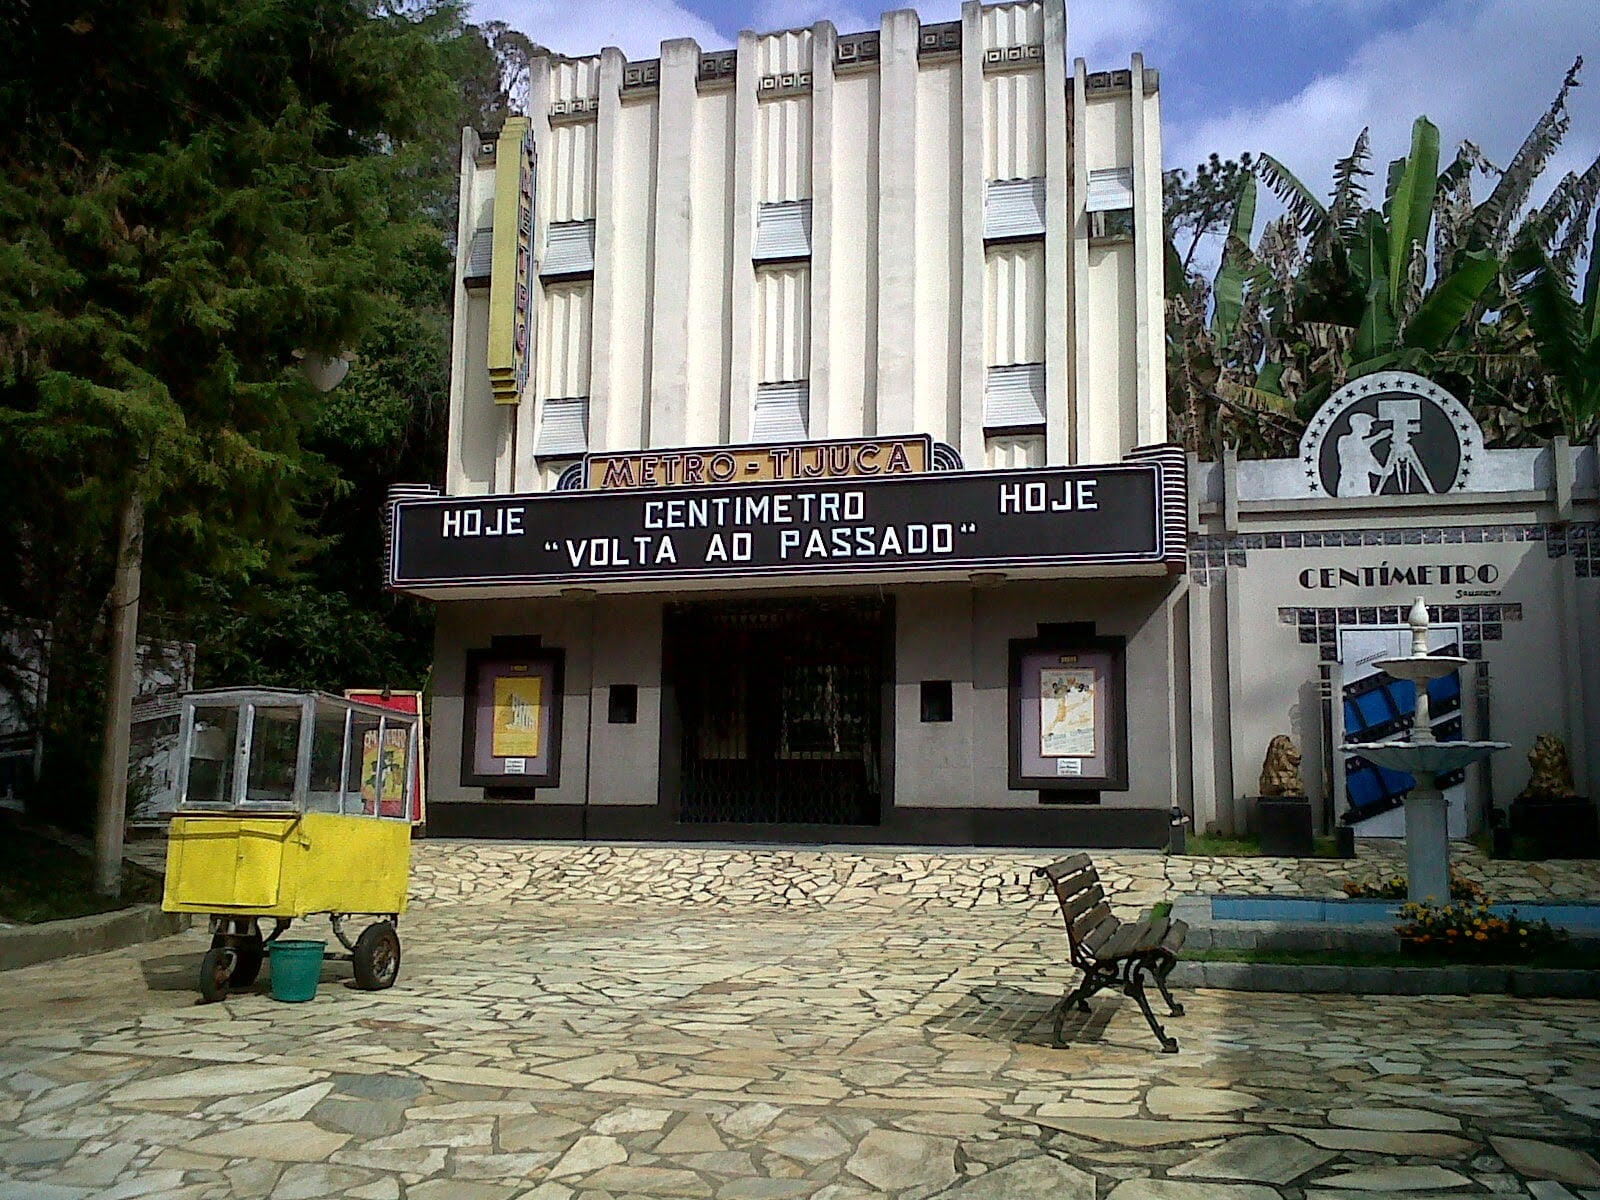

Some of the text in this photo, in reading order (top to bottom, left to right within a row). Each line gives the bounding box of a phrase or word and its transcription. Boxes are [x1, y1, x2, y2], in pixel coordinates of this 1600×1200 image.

[601, 453, 736, 487] METRO
[769, 442, 913, 480] TIJUCA
[644, 491, 865, 529] CENTIMETRO
[999, 479, 1099, 515] HOJE
[442, 507, 525, 538] HOJE
[705, 531, 752, 563] AO
[1298, 560, 1500, 590] CENTÍMETRO
